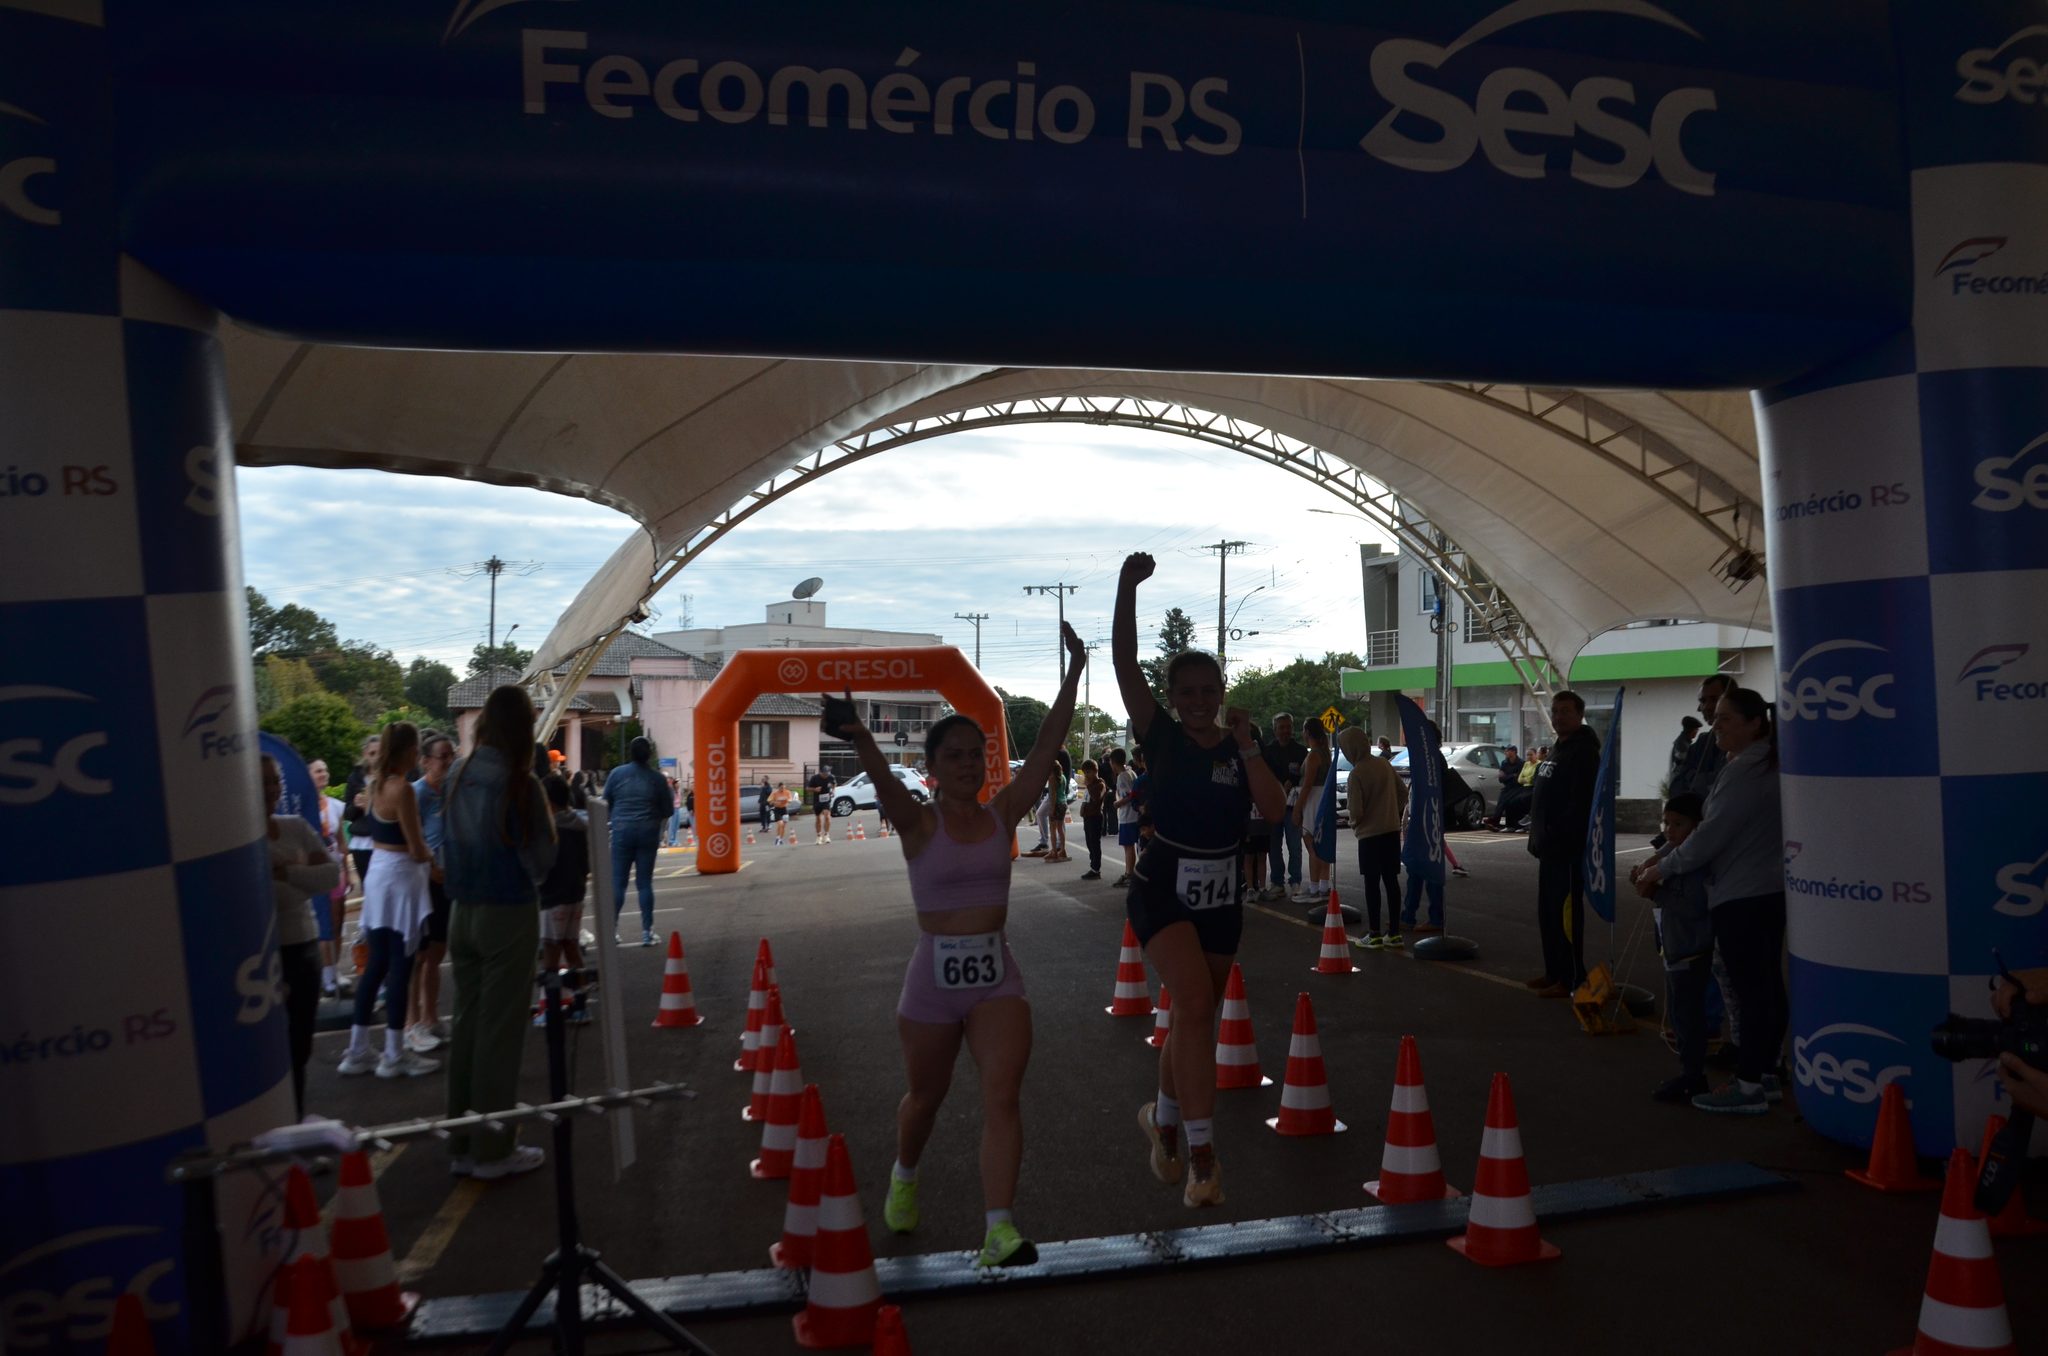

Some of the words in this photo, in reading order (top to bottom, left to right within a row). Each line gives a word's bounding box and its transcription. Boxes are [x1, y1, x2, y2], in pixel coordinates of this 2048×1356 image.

[521, 28, 1095, 144] Fecomércio
[1127, 71, 1242, 156] RS
[1953, 47, 2048, 106] Se
[1359, 36, 1718, 197] Sesc
[62, 464, 119, 496] RS
[1869, 482, 1911, 507] RS
[816, 658, 924, 681] CRESOL
[984, 724, 1005, 801] RESOL
[707, 735, 728, 827] CRESOL
[1187, 877, 1229, 906] 514
[1892, 881, 1932, 904] RS
[944, 955, 996, 985] 663
[124, 1007, 177, 1045] RS
